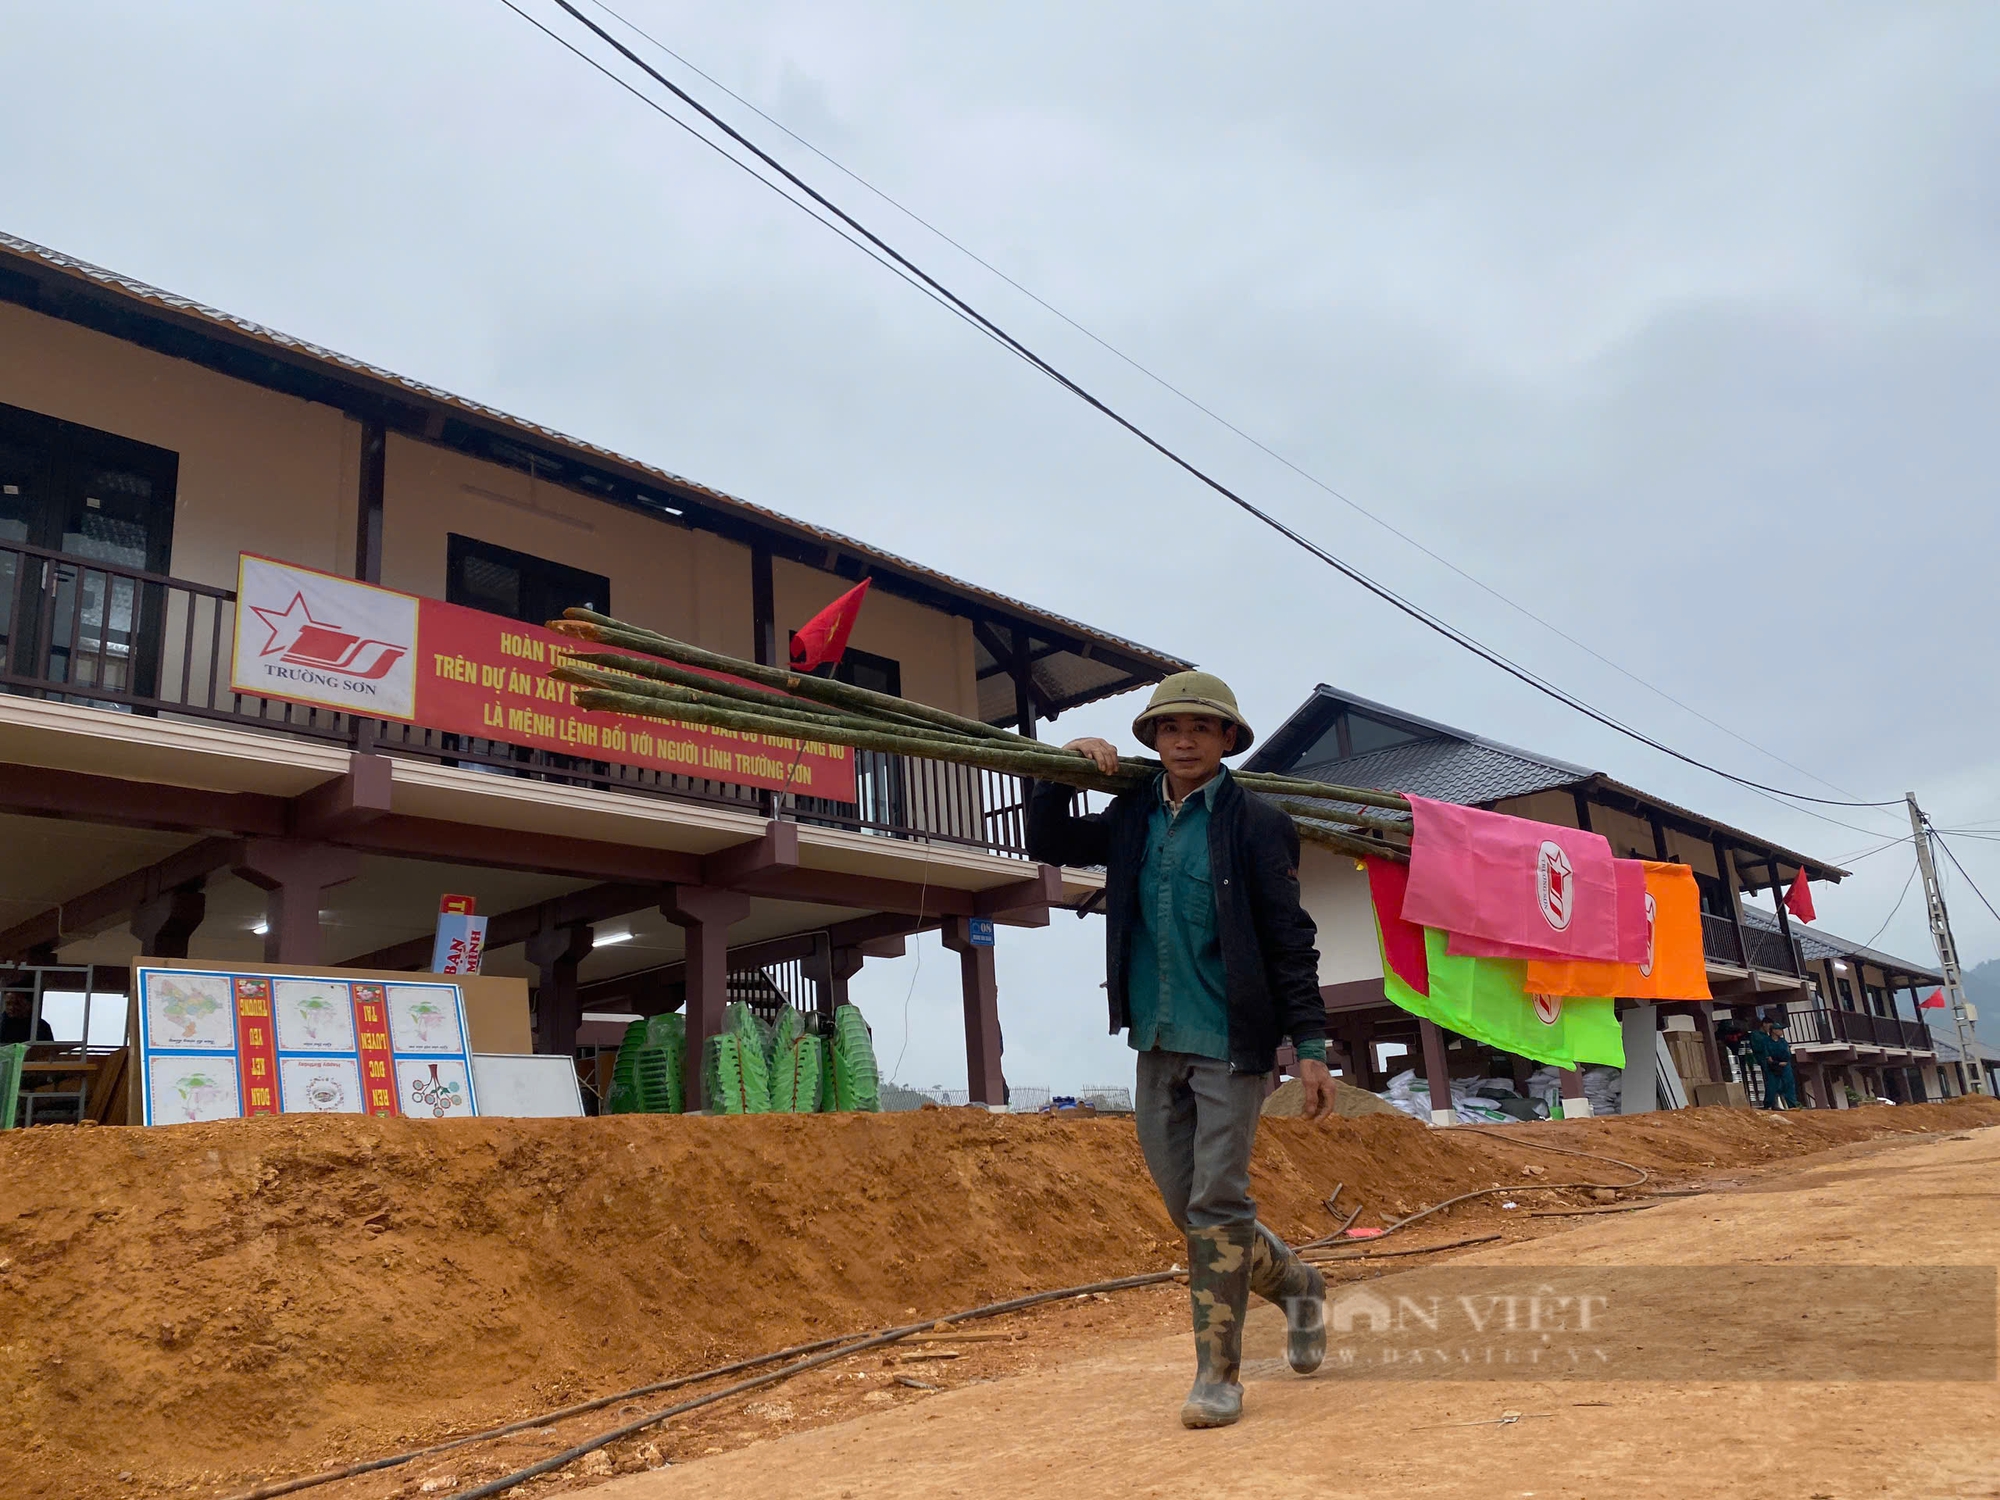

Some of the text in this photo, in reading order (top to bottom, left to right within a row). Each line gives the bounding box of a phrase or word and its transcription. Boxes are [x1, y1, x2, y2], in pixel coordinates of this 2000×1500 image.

[500, 632, 544, 662] HOÀN
[264, 664, 377, 695] TRƯỜNG SƠN
[434, 654, 477, 685] TRÊN
[482, 665, 506, 694] DỰ
[508, 667, 531, 696] ÁN
[484, 701, 503, 728] LÀ
[508, 707, 555, 738] MỆNH
[559, 717, 598, 746] LỆNH
[602, 723, 626, 752] ĐỐI
[630, 731, 653, 757] VỚI
[657, 739, 699, 766] NGƯỜI
[702, 744, 732, 772] LÍNH
[735, 753, 784, 781] TRƯỜNG
[787, 763, 812, 785] SƠN
[443, 937, 466, 975] BẠN
[465, 930, 482, 973] MÌNH
[251, 1057, 266, 1081] KẾT
